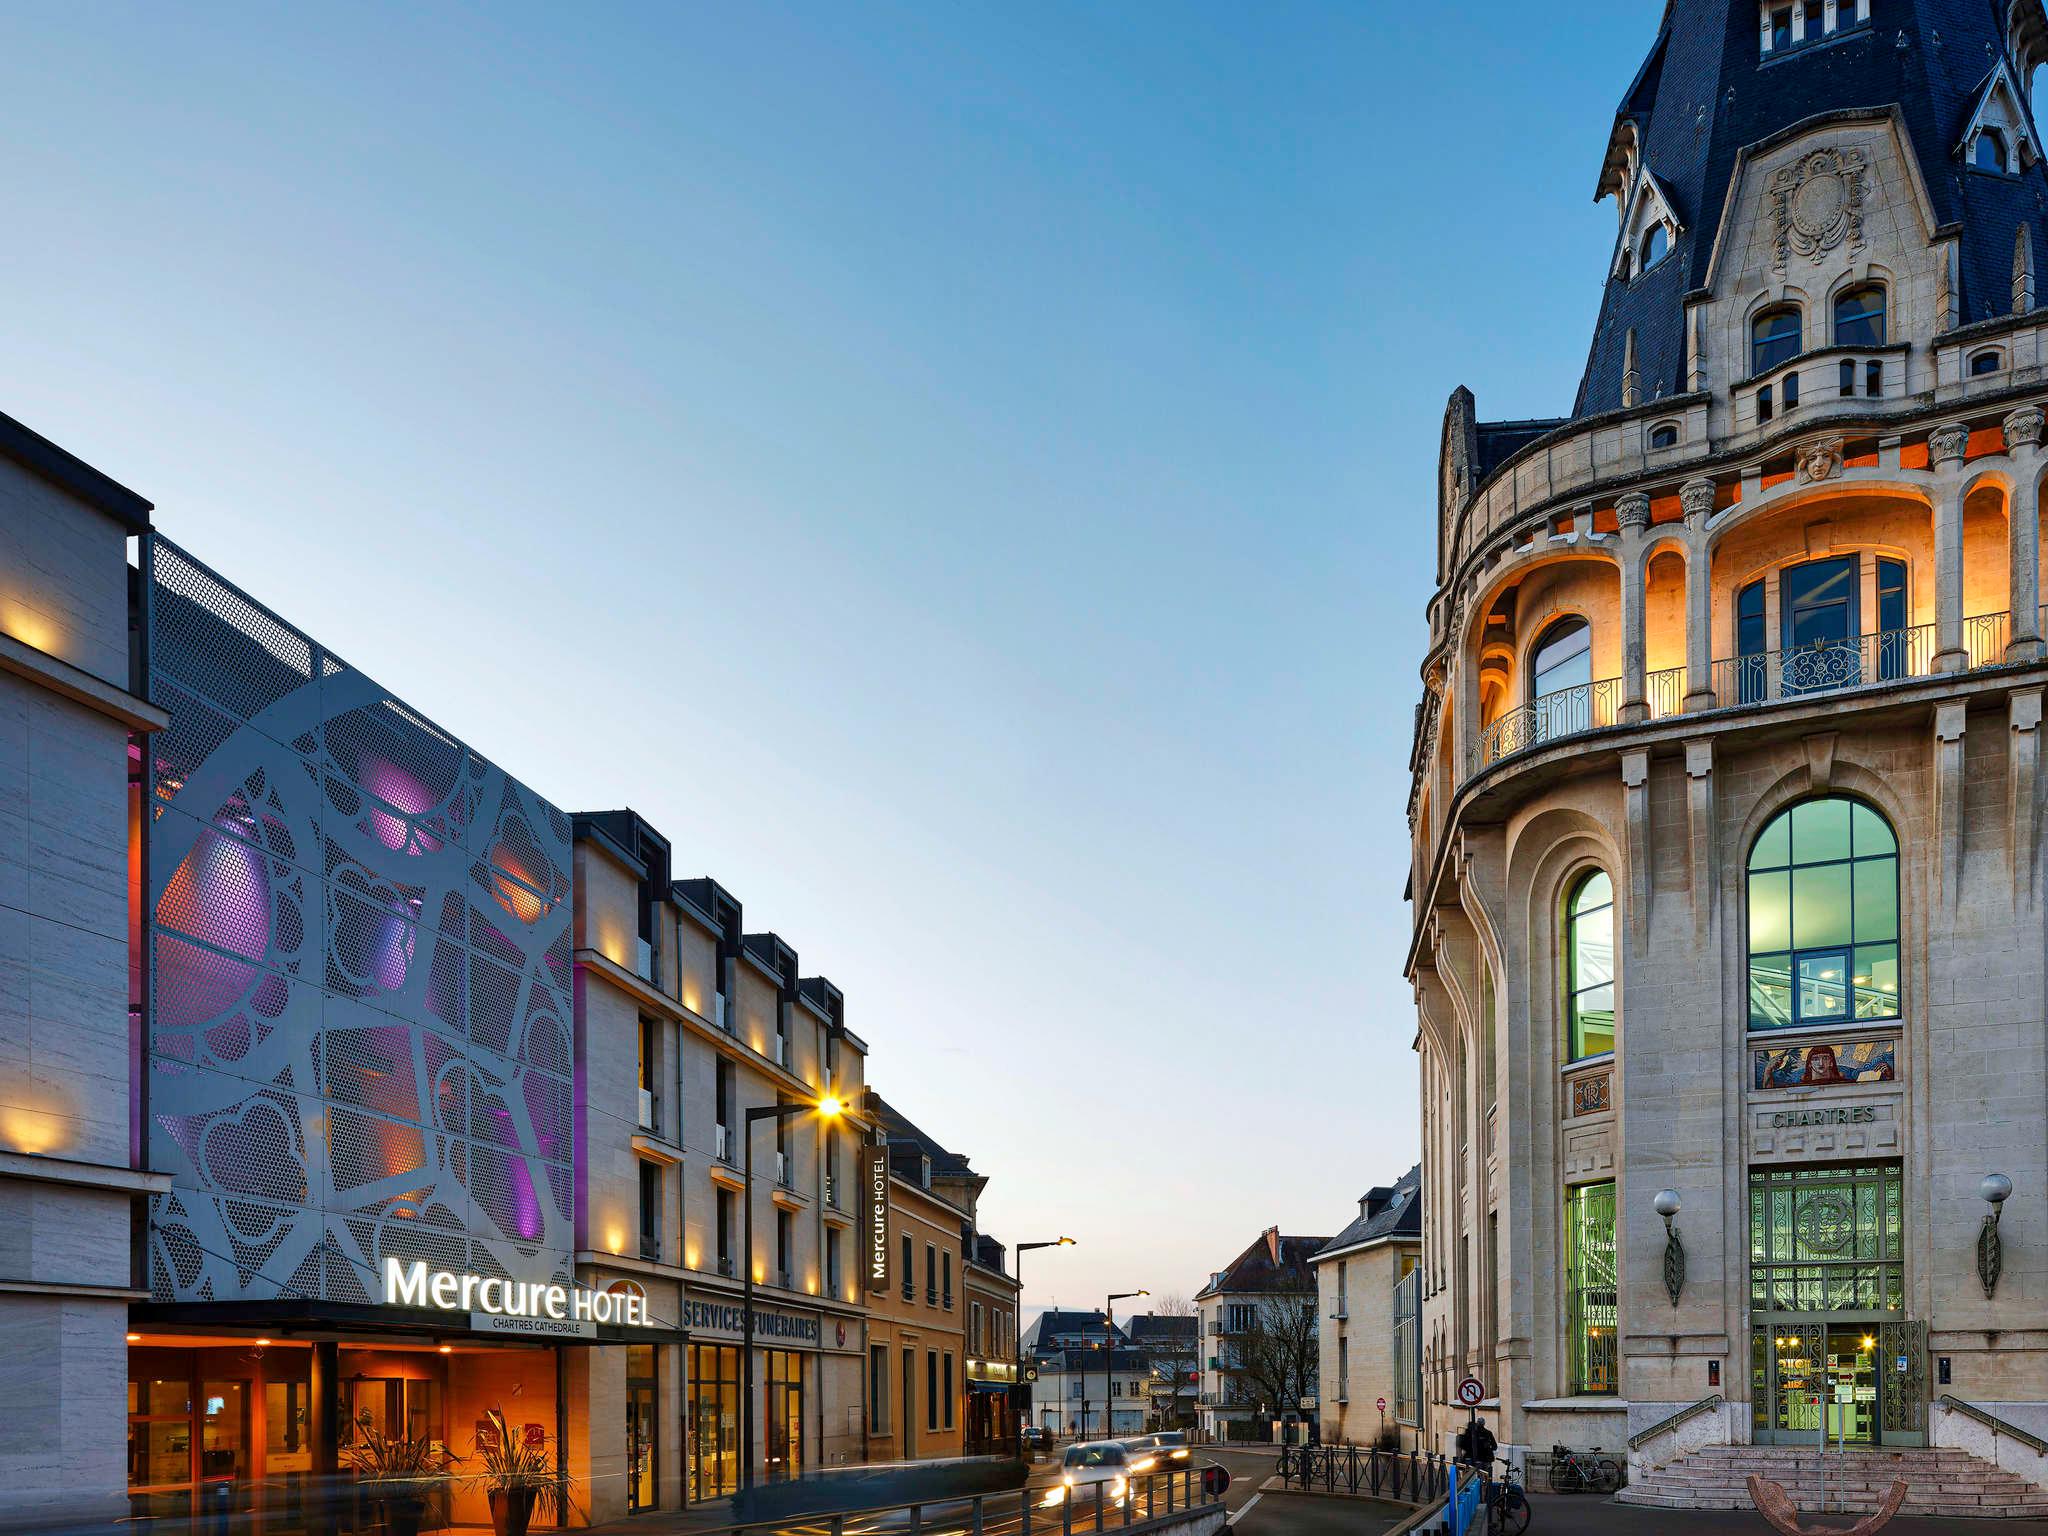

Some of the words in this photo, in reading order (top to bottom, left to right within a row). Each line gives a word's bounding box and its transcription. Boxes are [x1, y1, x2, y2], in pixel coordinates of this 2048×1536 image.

[1773, 1107, 1875, 1128] CHARTRES
[873, 1156, 884, 1201] HOTEL
[872, 1204, 885, 1279] Mercure
[384, 1257, 567, 1320] Mercure
[573, 1288, 654, 1327] HOTEL
[492, 1318, 533, 1330] CHARTRES
[534, 1320, 581, 1334] CATHEDRALE
[751, 1309, 817, 1341] FUNÉRAIRES
